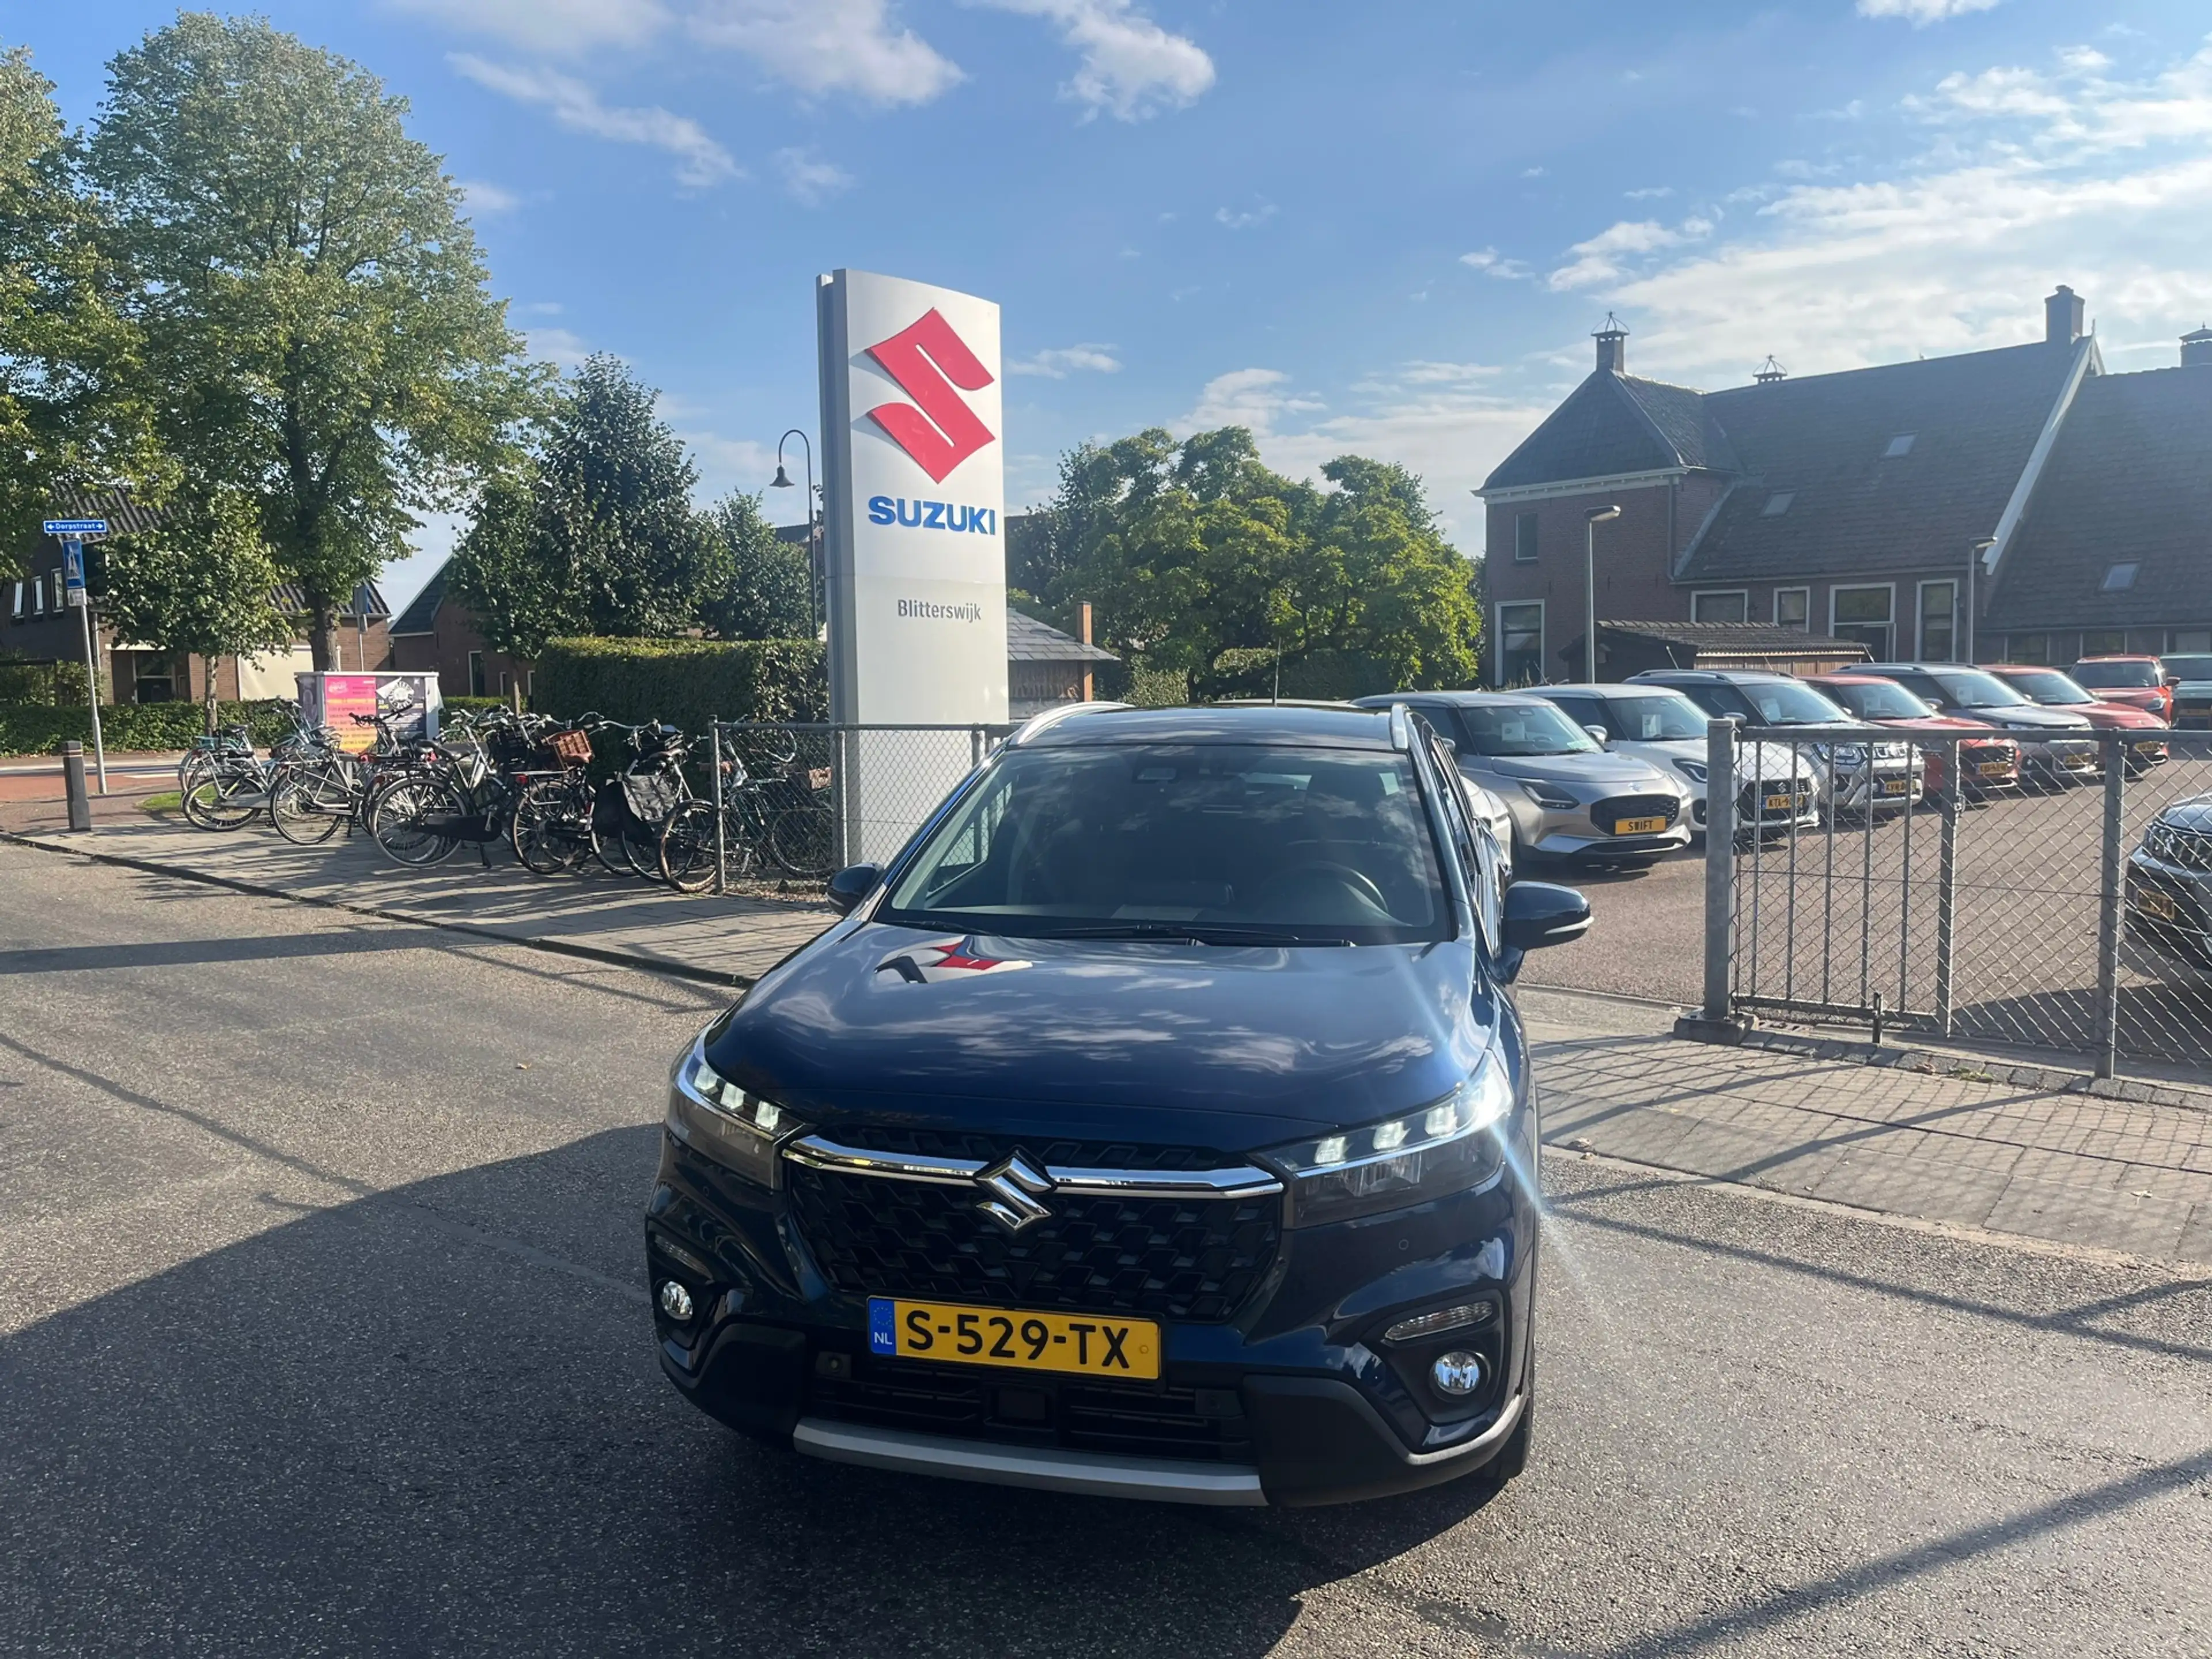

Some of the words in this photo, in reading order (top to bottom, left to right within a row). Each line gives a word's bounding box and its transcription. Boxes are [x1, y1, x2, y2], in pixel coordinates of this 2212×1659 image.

[868, 495, 996, 535] SUZUKI
[897, 599, 982, 623] Blitterswijk
[874, 1331, 893, 1345] NL
[906, 1310, 1130, 1369] S-529-TX
